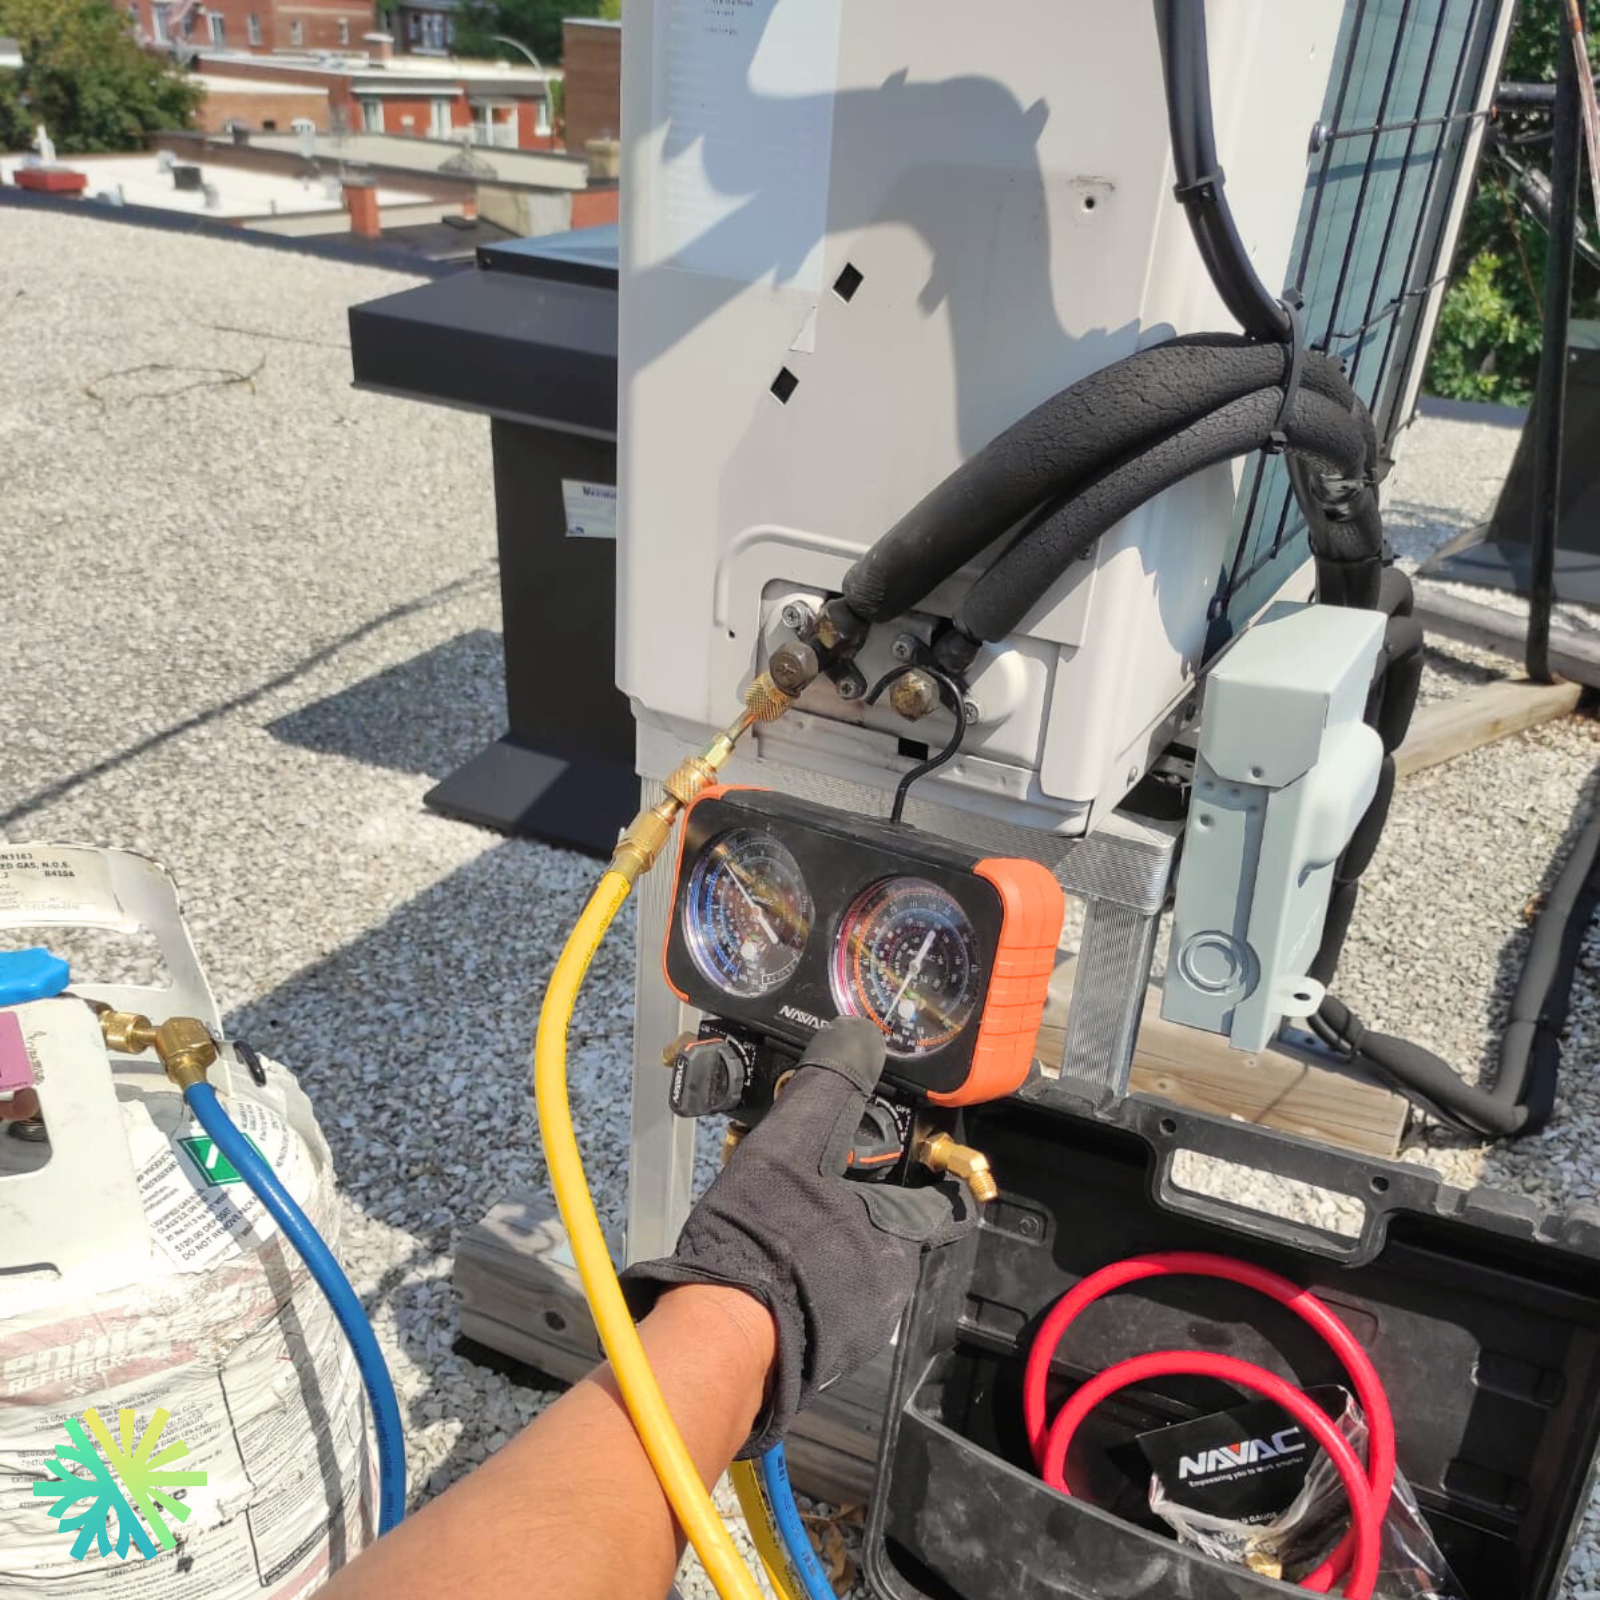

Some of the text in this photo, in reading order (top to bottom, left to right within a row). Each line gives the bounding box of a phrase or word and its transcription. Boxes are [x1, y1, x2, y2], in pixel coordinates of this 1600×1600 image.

[181, 1247, 196, 1261] DO
[194, 1235, 213, 1251] NOT
[1178, 1426, 1306, 1480] NAVAC
